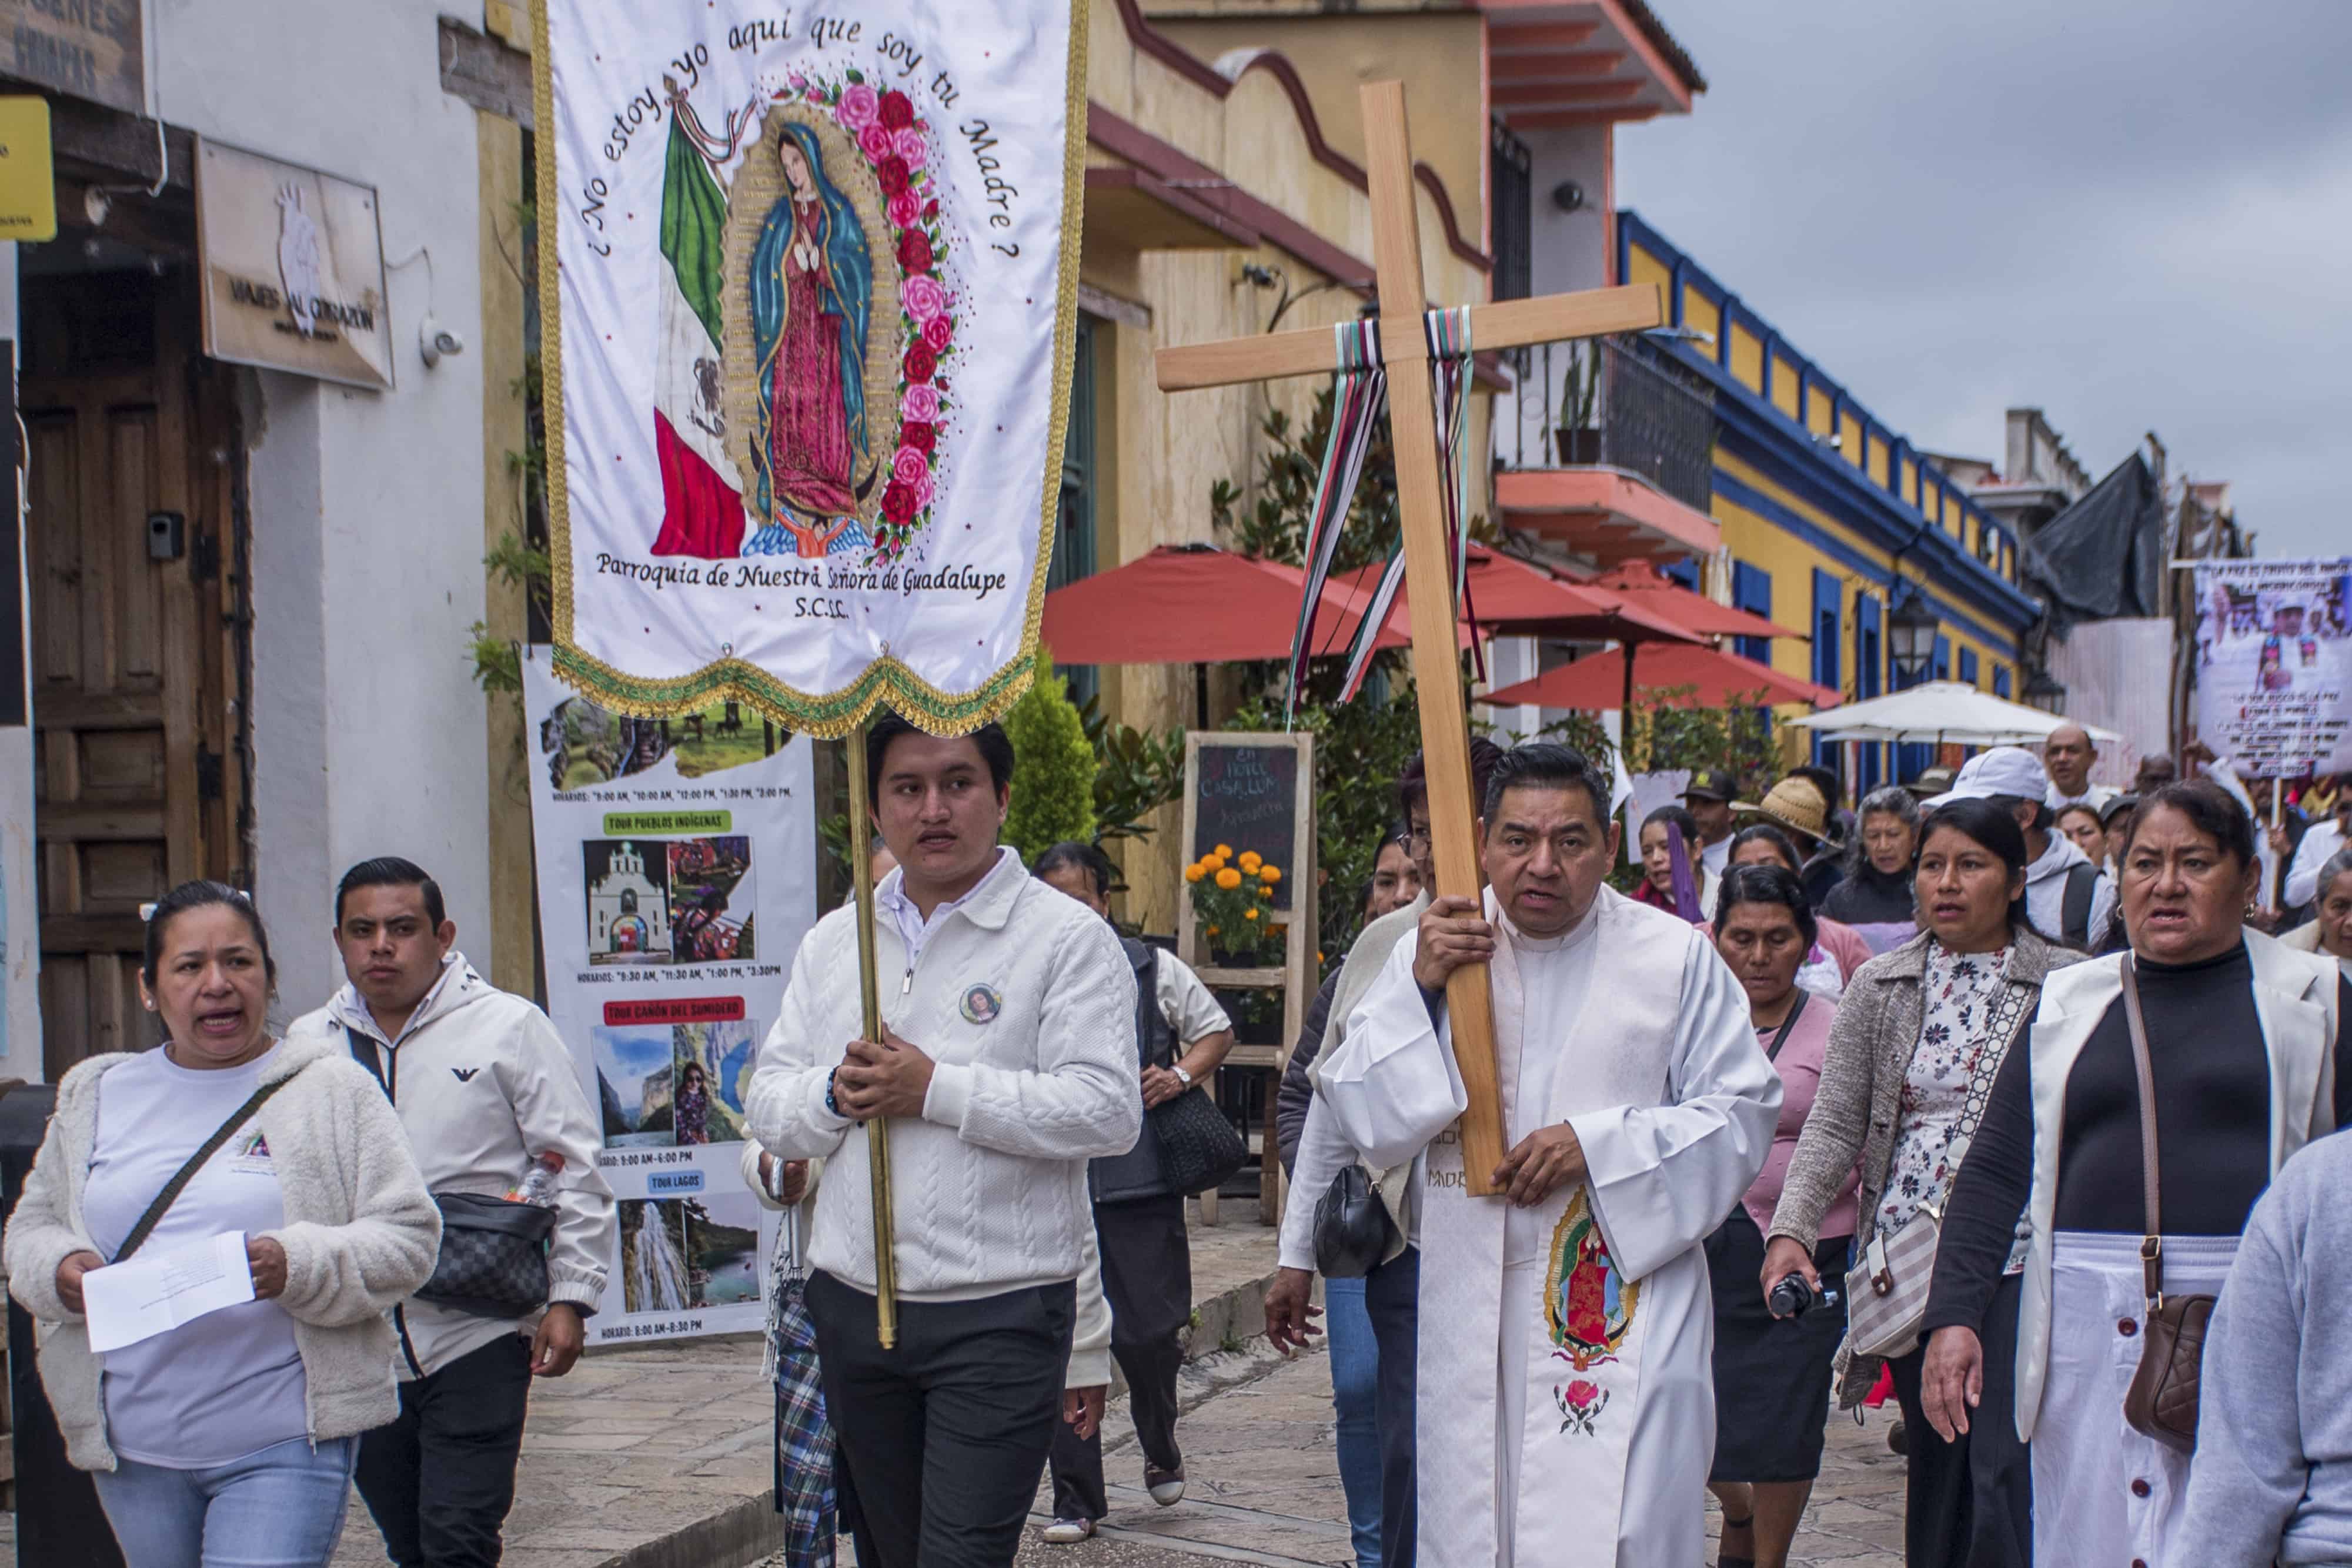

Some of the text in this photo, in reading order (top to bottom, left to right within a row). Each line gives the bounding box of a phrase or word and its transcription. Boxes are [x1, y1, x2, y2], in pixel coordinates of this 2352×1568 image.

[604, 87, 662, 162] estoy
[671, 42, 708, 89] yo
[811, 15, 861, 49] que
[877, 31, 922, 78] soy
[931, 69, 959, 110] tu
[596, 553, 1006, 600] Parroquia de Nuestra Señora de Guadalupe
[609, 813, 721, 829] TOUR PUEBLOS INDÍGENAS
[608, 1005, 631, 1019] TOUR
[670, 1005, 688, 1017] DEL
[690, 1002, 739, 1016] SUMIDERO
[679, 1151, 692, 1162] PM
[652, 1175, 699, 1189] TOUR LAGOS
[602, 1326, 633, 1339] HORARIO:
[634, 1324, 653, 1336] 8:00
[690, 1319, 702, 1331] PM
